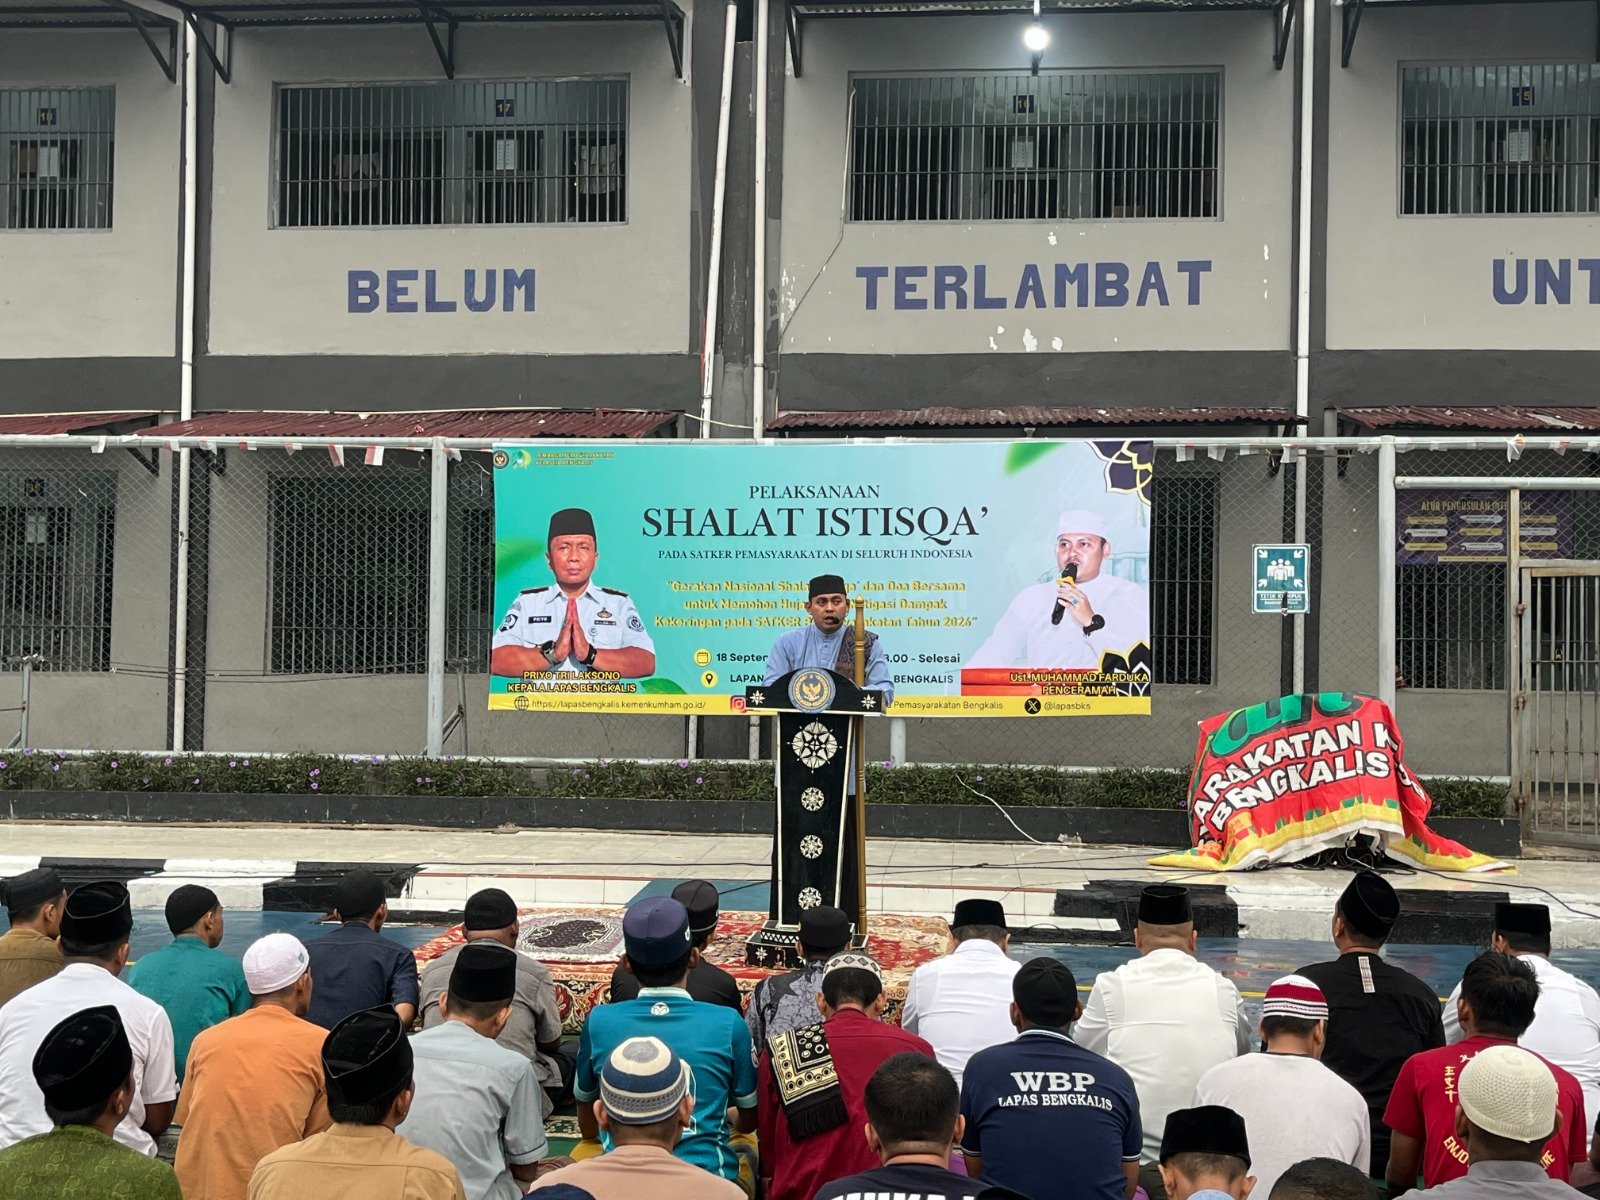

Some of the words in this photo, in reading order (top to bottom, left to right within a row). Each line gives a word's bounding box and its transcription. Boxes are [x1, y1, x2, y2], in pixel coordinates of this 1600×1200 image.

[348, 268, 536, 313] BELUM
[855, 260, 1212, 310] TERLAMBAT
[749, 485, 880, 499] PELAKSANAAN
[642, 507, 805, 537] SHALAT
[658, 550, 688, 559] PADA
[690, 550, 732, 559] SATKER
[735, 550, 838, 559] PEMASYARAKATAN
[841, 550, 853, 559] DI
[856, 549, 908, 559] SELURUH
[911, 549, 973, 559] INDONESIA
[724, 581, 775, 592] Nasional
[778, 581, 809, 592] Shala
[863, 580, 885, 592] dan
[888, 580, 910, 592] Doa
[912, 580, 966, 592] Bersama
[684, 598, 718, 610] untuk
[720, 598, 777, 610] Memohon
[781, 599, 805, 612] Huja
[900, 598, 948, 612] Dampak
[655, 616, 721, 629] Kekeringan
[724, 616, 752, 629] pada
[755, 616, 802, 627] SATKER
[905, 615, 941, 627] Tahun
[716, 653, 728, 662] 18
[918, 653, 961, 663] Selesai
[523, 671, 552, 681] PRIYO
[555, 671, 570, 681] TRI
[572, 671, 620, 681] LAKSONO
[893, 674, 954, 684] BENGKALIS
[1031, 672, 1097, 682] MUHAMMAD
[1099, 672, 1149, 682] FARDUKA
[507, 683, 544, 693] KEPALA
[547, 683, 579, 693] LAPAS
[580, 683, 636, 693] BENGKALIS
[1042, 685, 1117, 695] PENCERAMAH
[893, 701, 960, 711] Pemasyarakatan
[963, 701, 1003, 711] Bengkalis
[1044, 702, 1091, 711] @lapasbks
[1211, 751, 1390, 831] BENGKALIS
[1010, 1071, 1096, 1092] WBP
[998, 1094, 1038, 1107] LAPAS
[1041, 1093, 1113, 1111] BENGKALIS
